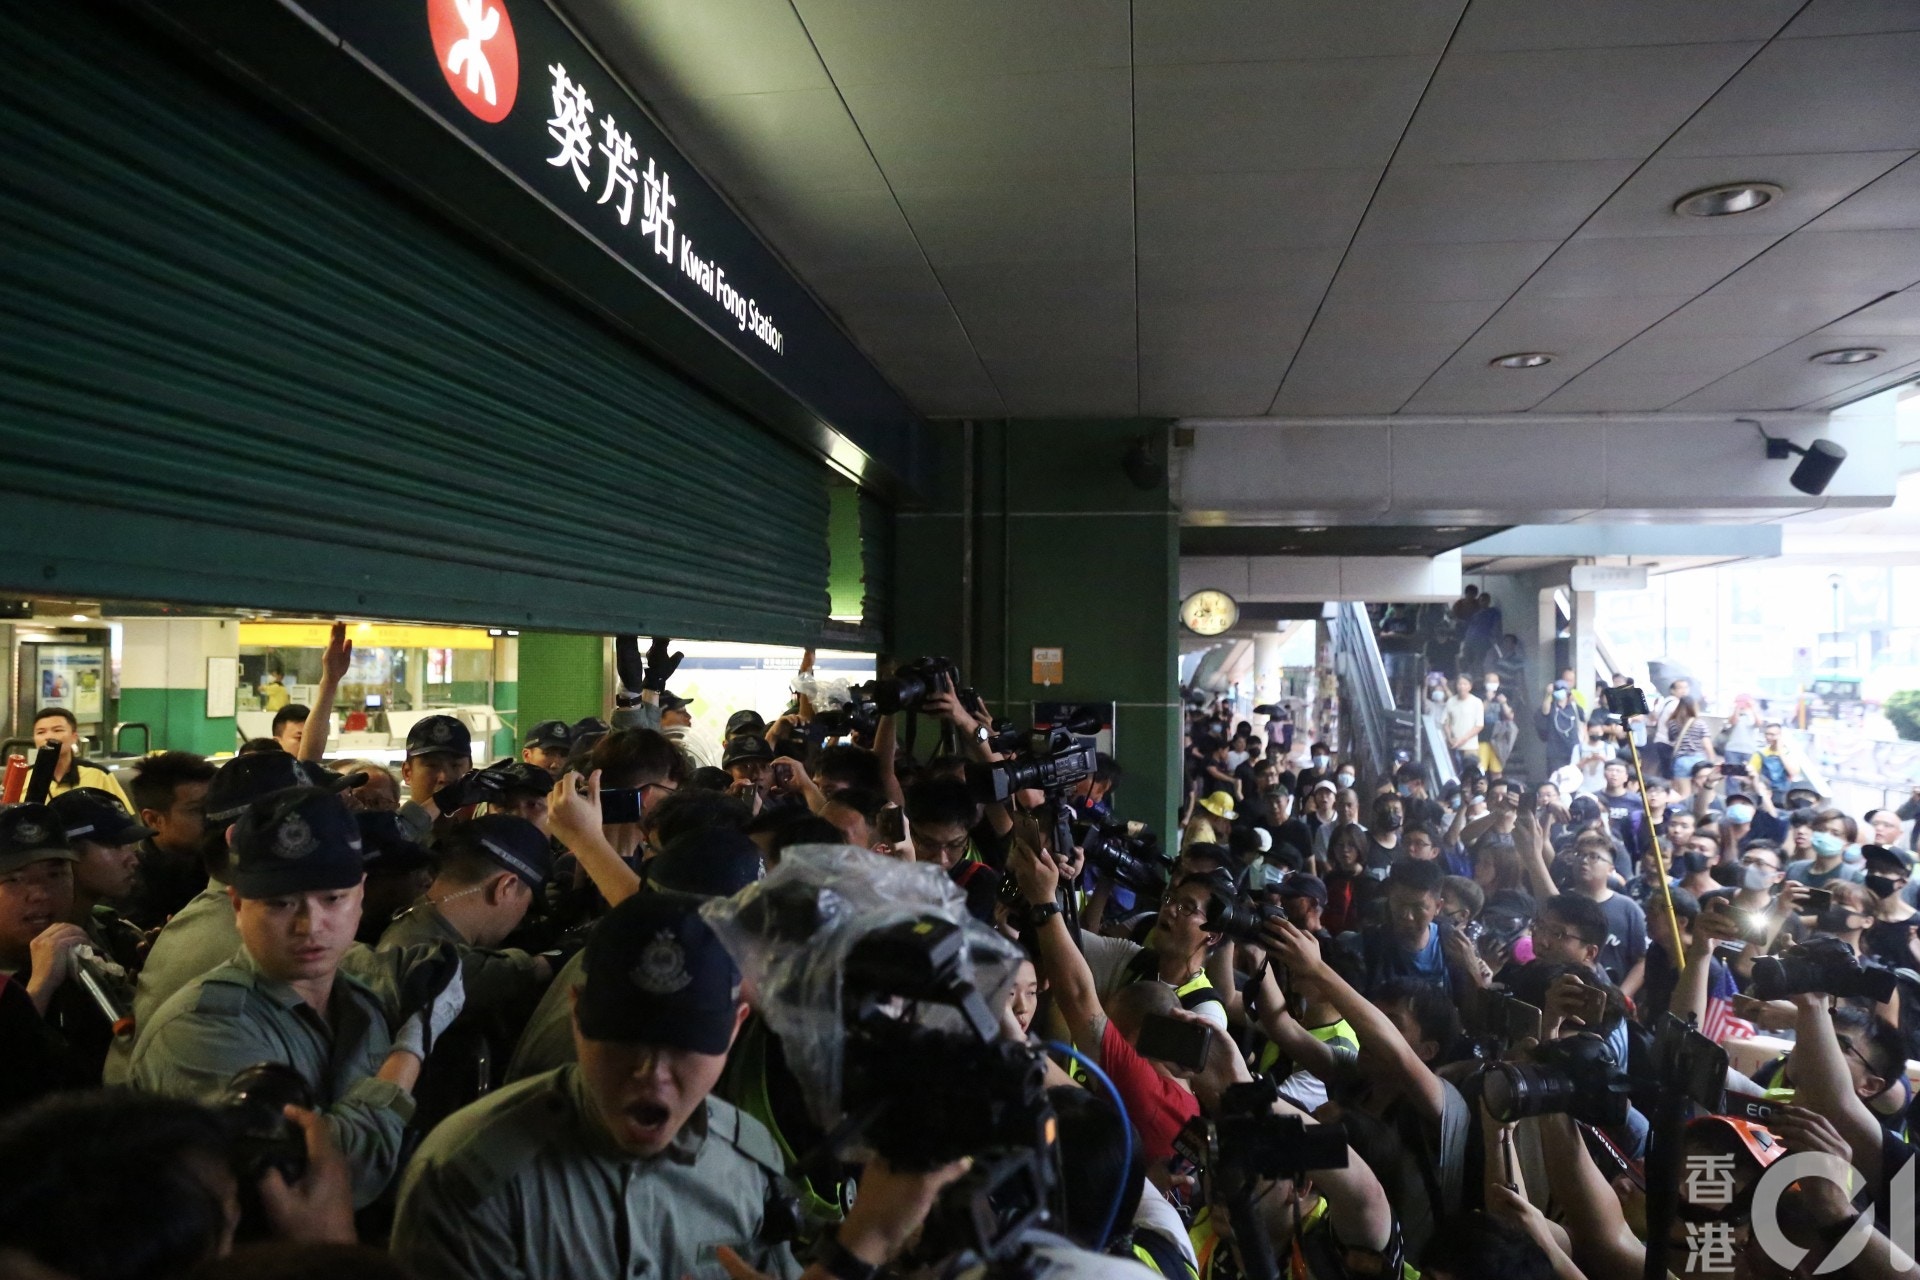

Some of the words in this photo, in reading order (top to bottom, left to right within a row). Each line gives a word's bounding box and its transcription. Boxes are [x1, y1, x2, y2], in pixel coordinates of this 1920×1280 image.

[546, 62, 677, 264] 葵芳站
[680, 233, 715, 296] Kwai
[716, 266, 747, 332] Fong
[748, 298, 784, 357] Station
[1591, 1126, 1628, 1169] Canon
[1746, 1103, 1772, 1118] EO
